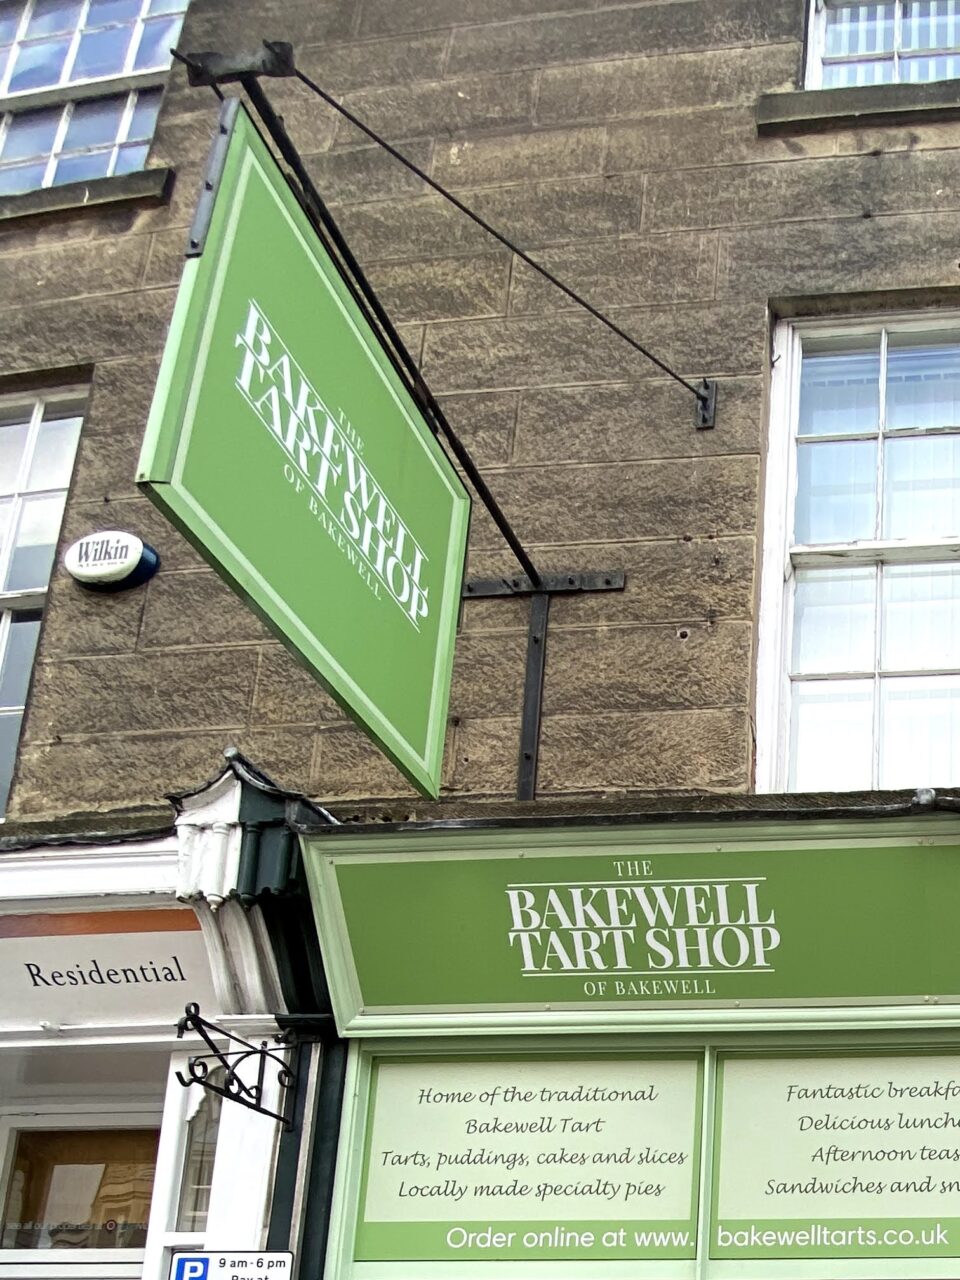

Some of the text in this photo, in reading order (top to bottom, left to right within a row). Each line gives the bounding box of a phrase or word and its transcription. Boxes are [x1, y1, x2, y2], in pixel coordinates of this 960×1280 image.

[338, 407, 365, 455] THE
[244, 301, 429, 592] BAKEWELL
[235, 333, 429, 626] TART SHOP
[283, 463, 382, 600] OF BAKEWELL
[78, 539, 129, 562] Wilkin
[613, 860, 653, 876] THE
[505, 884, 775, 930] BAKEWELL
[508, 926, 781, 970] TART SHOP
[24, 956, 187, 987] Residential
[584, 980, 716, 996] OF BAKEWELL
[418, 1085, 659, 1106] Home of the traditional
[787, 1083, 884, 1102] Fantastic
[465, 1117, 606, 1135] Bakewell Tart
[798, 1114, 894, 1131] Delicious
[381, 1147, 688, 1171] Tarts, puddings, cakes and slices
[811, 1145, 917, 1164] Afternoon
[398, 1179, 666, 1202] Locally made specialty pies
[765, 1176, 887, 1195] Sandwiches
[890, 1176, 937, 1193] and
[446, 1226, 695, 1248] Order online at www.
[717, 1223, 949, 1247] bakewelltarts.co.uk
[219, 1258, 286, 1269] 9 am 6 pm
